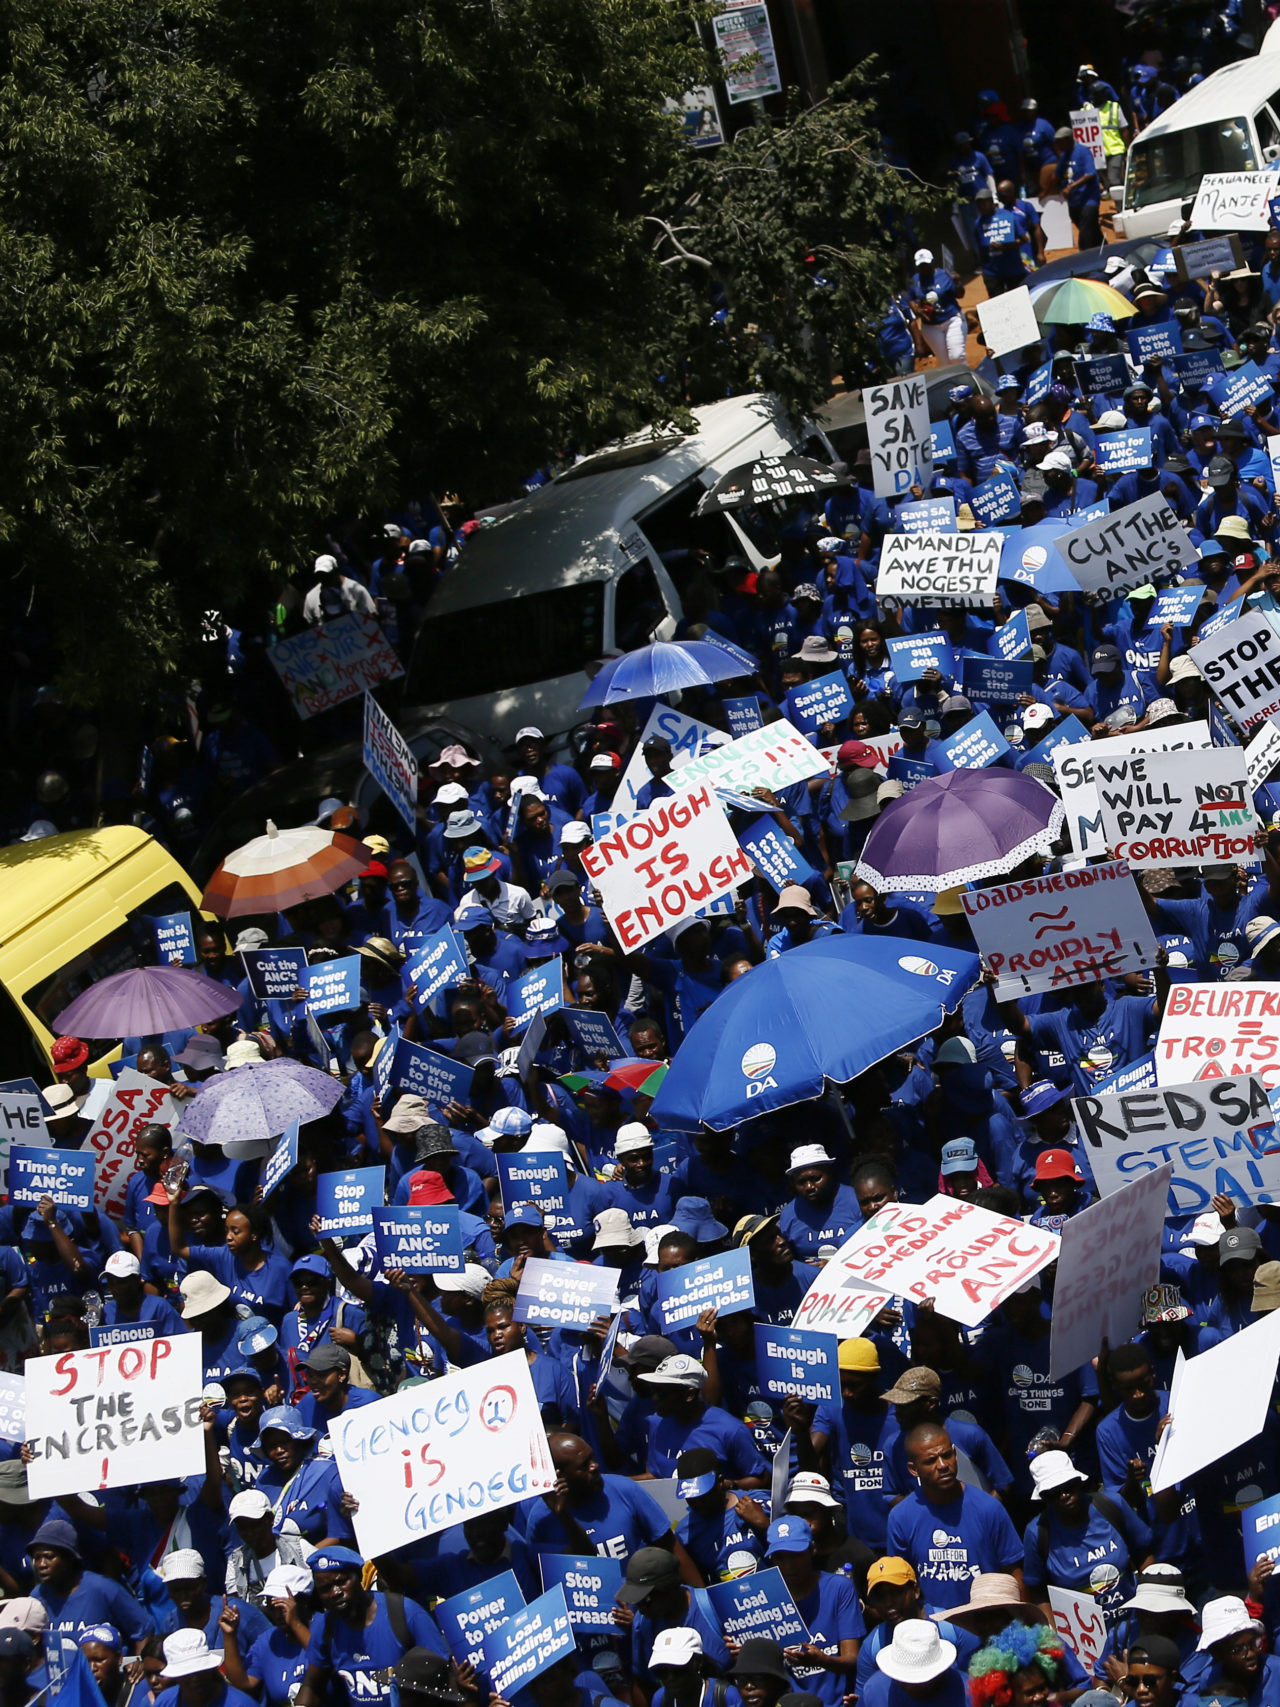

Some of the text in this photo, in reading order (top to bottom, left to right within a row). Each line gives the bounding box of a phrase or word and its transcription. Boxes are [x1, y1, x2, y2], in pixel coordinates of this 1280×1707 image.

[1203, 175, 1271, 186] SEKWANELE
[1089, 378, 1122, 390] rip-off!
[871, 383, 925, 416] SAVE
[880, 415, 916, 447] SA
[873, 438, 932, 471] VOTE
[1099, 438, 1143, 452] Time for
[1110, 449, 1137, 460] ANC-
[894, 467, 923, 492] DA
[972, 491, 994, 507] Save
[977, 493, 1015, 515] vote out
[990, 506, 1010, 520] ANC
[887, 536, 1000, 554] AMANDLA
[1068, 507, 1178, 564] CUT THE
[885, 557, 993, 575] AWETHU
[1203, 629, 1271, 683] STOP
[794, 691, 823, 708] Save
[800, 695, 848, 718] vote out
[816, 708, 841, 725] ANC
[1098, 759, 1147, 783] WE
[1102, 781, 1248, 810] WILL NOT
[581, 786, 711, 878] ENOUGH
[1117, 810, 1217, 836] PAY 4
[635, 842, 689, 888] IS
[988, 928, 1122, 975] PROUDLY
[257, 960, 297, 971] Cut the
[264, 972, 297, 981] ANC's
[1161, 1035, 1279, 1060] TROTS
[746, 1074, 777, 1099] DA
[1075, 1077, 1269, 1147] RED SA
[16, 1160, 85, 1176] Time for
[30, 1175, 73, 1189] ANC-
[334, 1184, 365, 1198] Stop
[338, 1200, 360, 1213] the
[380, 1222, 449, 1236] Time for
[399, 1237, 440, 1250] ANC-
[845, 1216, 927, 1270] LOAD
[863, 1204, 975, 1281] SHEDDING
[383, 1252, 459, 1268] shedding
[909, 1218, 1024, 1299] PROUDLY
[961, 1236, 1039, 1304] ANC
[540, 1274, 596, 1291] Power
[684, 1267, 723, 1290] Load
[561, 1290, 591, 1306] the
[661, 1274, 750, 1311] shedding is
[527, 1304, 595, 1324] people!
[801, 1292, 886, 1325] POWER
[767, 1342, 827, 1364] Enough
[50, 1340, 171, 1396] STOP
[792, 1364, 804, 1378] is
[768, 1378, 832, 1400] enough!
[70, 1391, 134, 1426] THE
[27, 1397, 204, 1459] INCREASE
[506, 1613, 542, 1649] Load
[488, 1616, 568, 1680] shedding is
[494, 1632, 570, 1694] killing jobs
